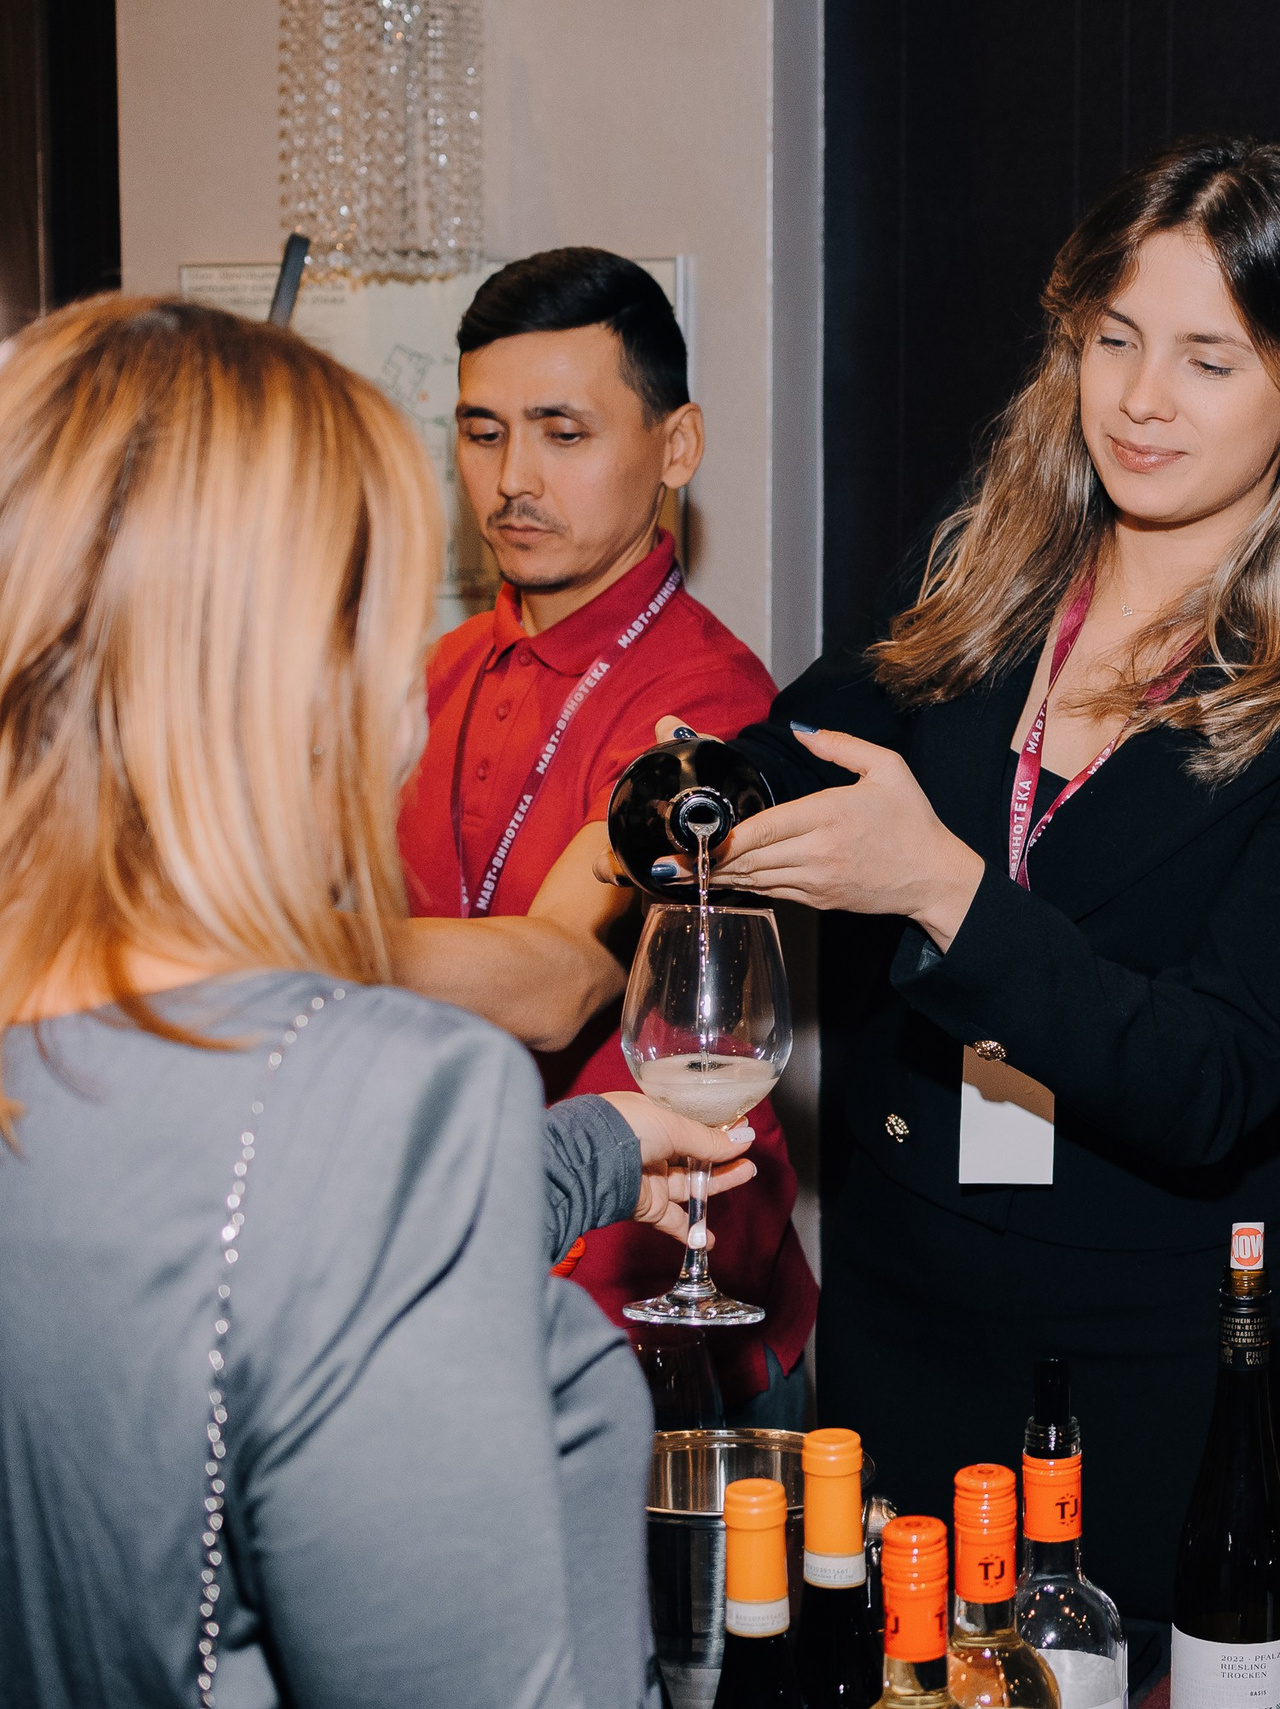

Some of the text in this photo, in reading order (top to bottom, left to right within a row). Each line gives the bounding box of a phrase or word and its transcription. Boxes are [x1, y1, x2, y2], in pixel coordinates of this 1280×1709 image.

[977, 1559, 1006, 1581] TJ
[1220, 1663, 1267, 1671] RIESLING
[1220, 1671, 1268, 1680] TROCKEN
